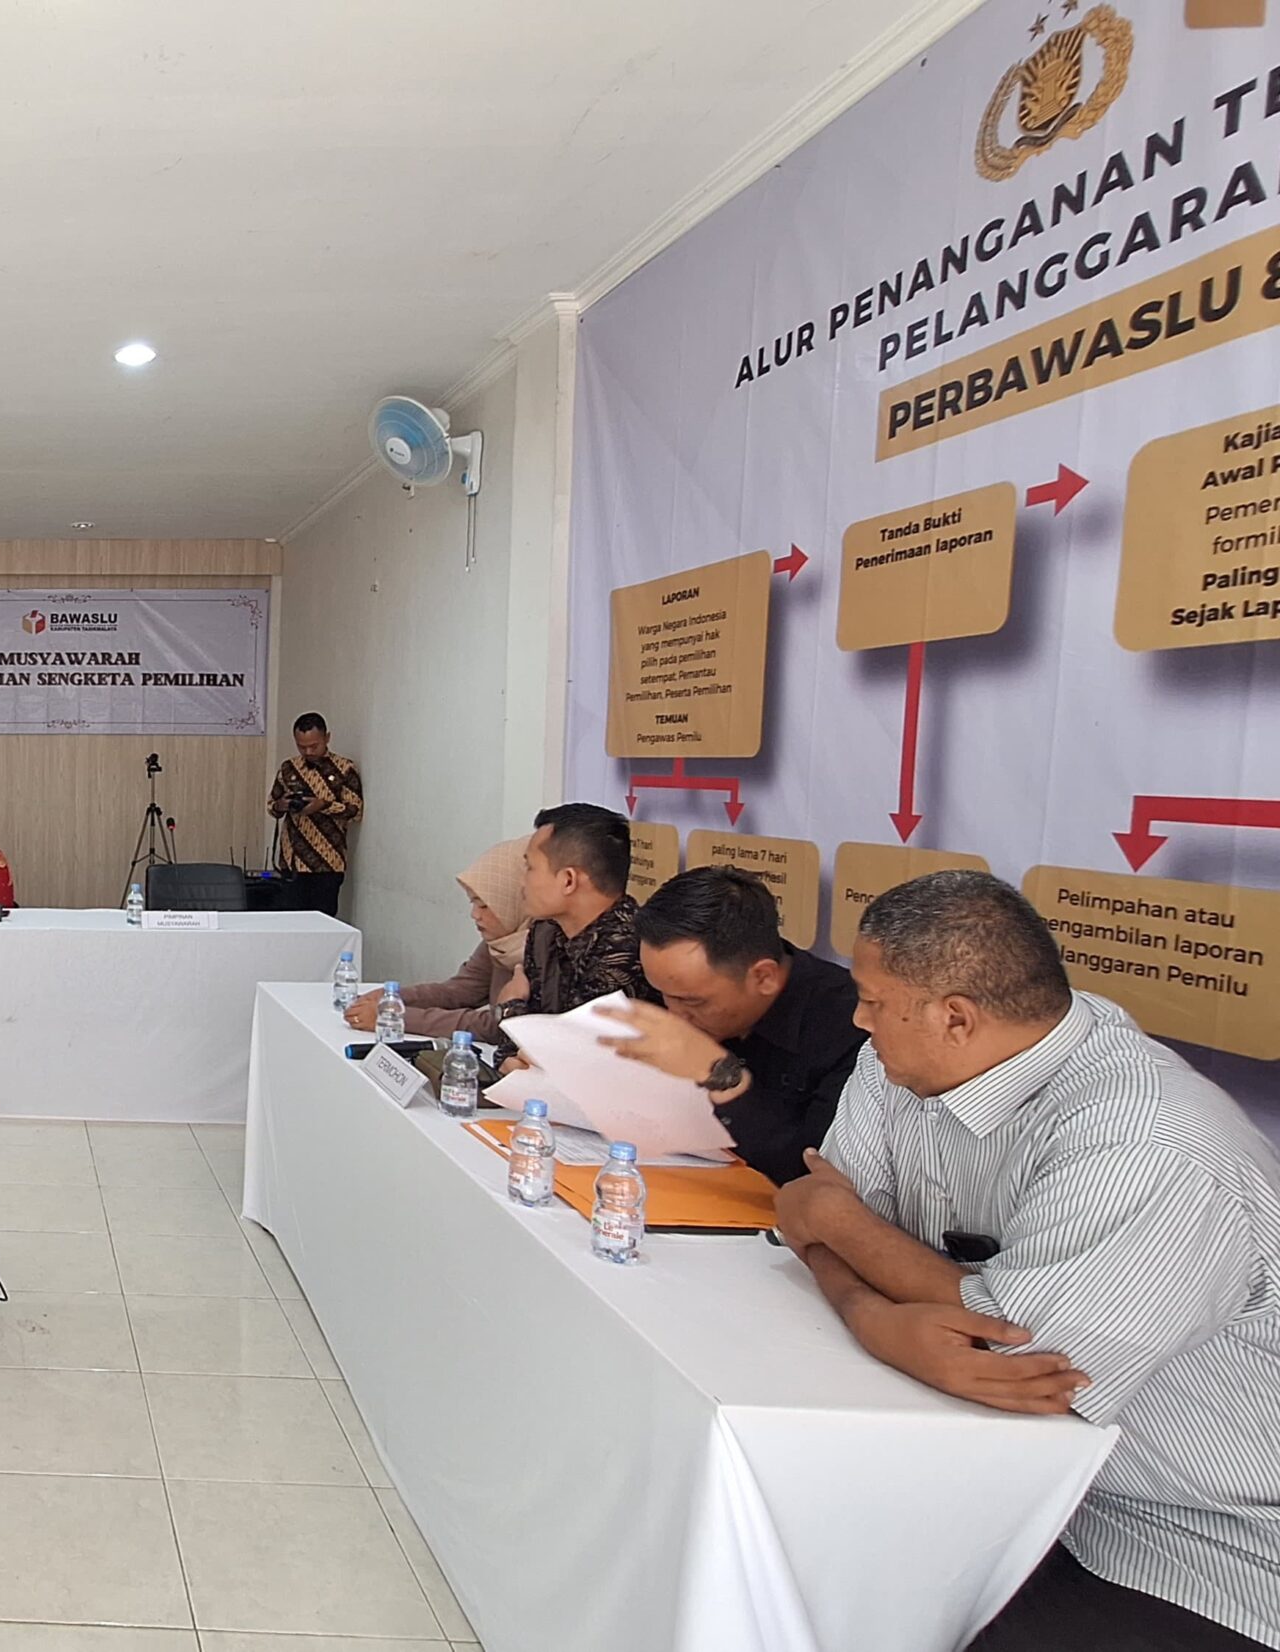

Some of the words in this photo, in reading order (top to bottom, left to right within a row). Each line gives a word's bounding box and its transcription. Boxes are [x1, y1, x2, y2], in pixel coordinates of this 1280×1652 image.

[735, 322, 815, 388] ALUR
[829, 116, 1186, 340] PENANGANAN
[878, 160, 1280, 371] PELANGGARA
[887, 265, 1242, 440] PERBAWASLU
[1200, 457, 1264, 490] Awal
[880, 522, 920, 542] Tanda
[923, 508, 962, 532] Bukti
[855, 544, 932, 571] Penerimaan
[936, 529, 994, 552] laporan
[1201, 565, 1279, 591] Paling
[662, 587, 700, 605] LAPORAN
[50, 613, 118, 624] BAWASLU
[638, 624, 662, 636] Warga
[663, 618, 687, 632] Negara
[689, 610, 727, 625] Indonesia
[1170, 602, 1235, 628] Sejak
[641, 641, 660, 653] yang
[661, 632, 704, 648] mempunyai
[705, 629, 721, 641] hak
[641, 656, 658, 669] pilih
[659, 654, 677, 668] pada
[679, 649, 717, 665] pemilihan
[37, 672, 134, 687] SENGKETA
[141, 673, 245, 688] PEMILIHAN
[679, 667, 717, 681] Pemantau
[665, 686, 692, 699] Peserta
[693, 683, 733, 697] Pemilihan
[655, 713, 688, 725] TEMUAN
[637, 732, 675, 745] Pengawas
[677, 730, 702, 743] Pemilu
[712, 844, 736, 860] paling
[738, 846, 759, 860] lama
[760, 849, 767, 861] 7
[768, 849, 787, 864] hari
[1057, 888, 1177, 920] Pelimpahan
[1184, 908, 1236, 929] atau
[1174, 935, 1265, 966] laporan
[1167, 966, 1249, 997] Pemilu
[377, 1055, 409, 1087] TERMOHON
